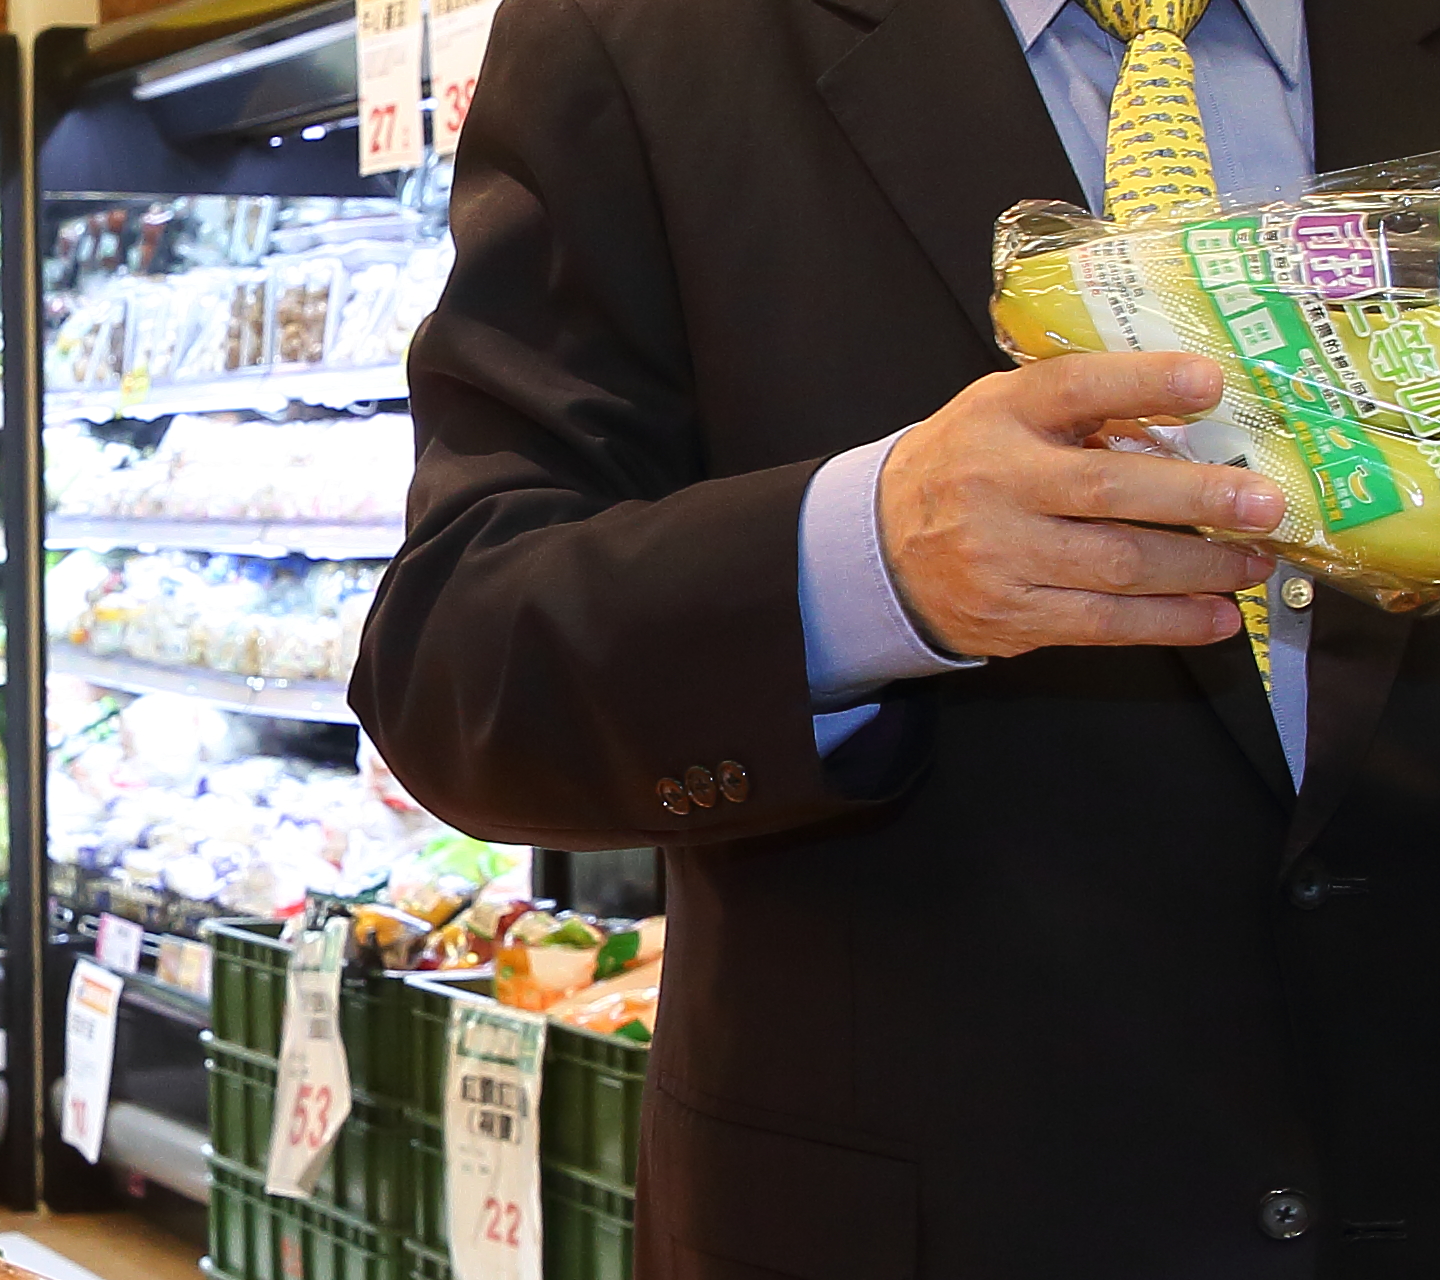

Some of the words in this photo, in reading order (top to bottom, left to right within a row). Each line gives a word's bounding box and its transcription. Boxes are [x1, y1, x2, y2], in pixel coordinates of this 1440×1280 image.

[370, 104, 397, 154] 27
[288, 1083, 333, 1148] 53
[482, 1196, 522, 1249] 22
